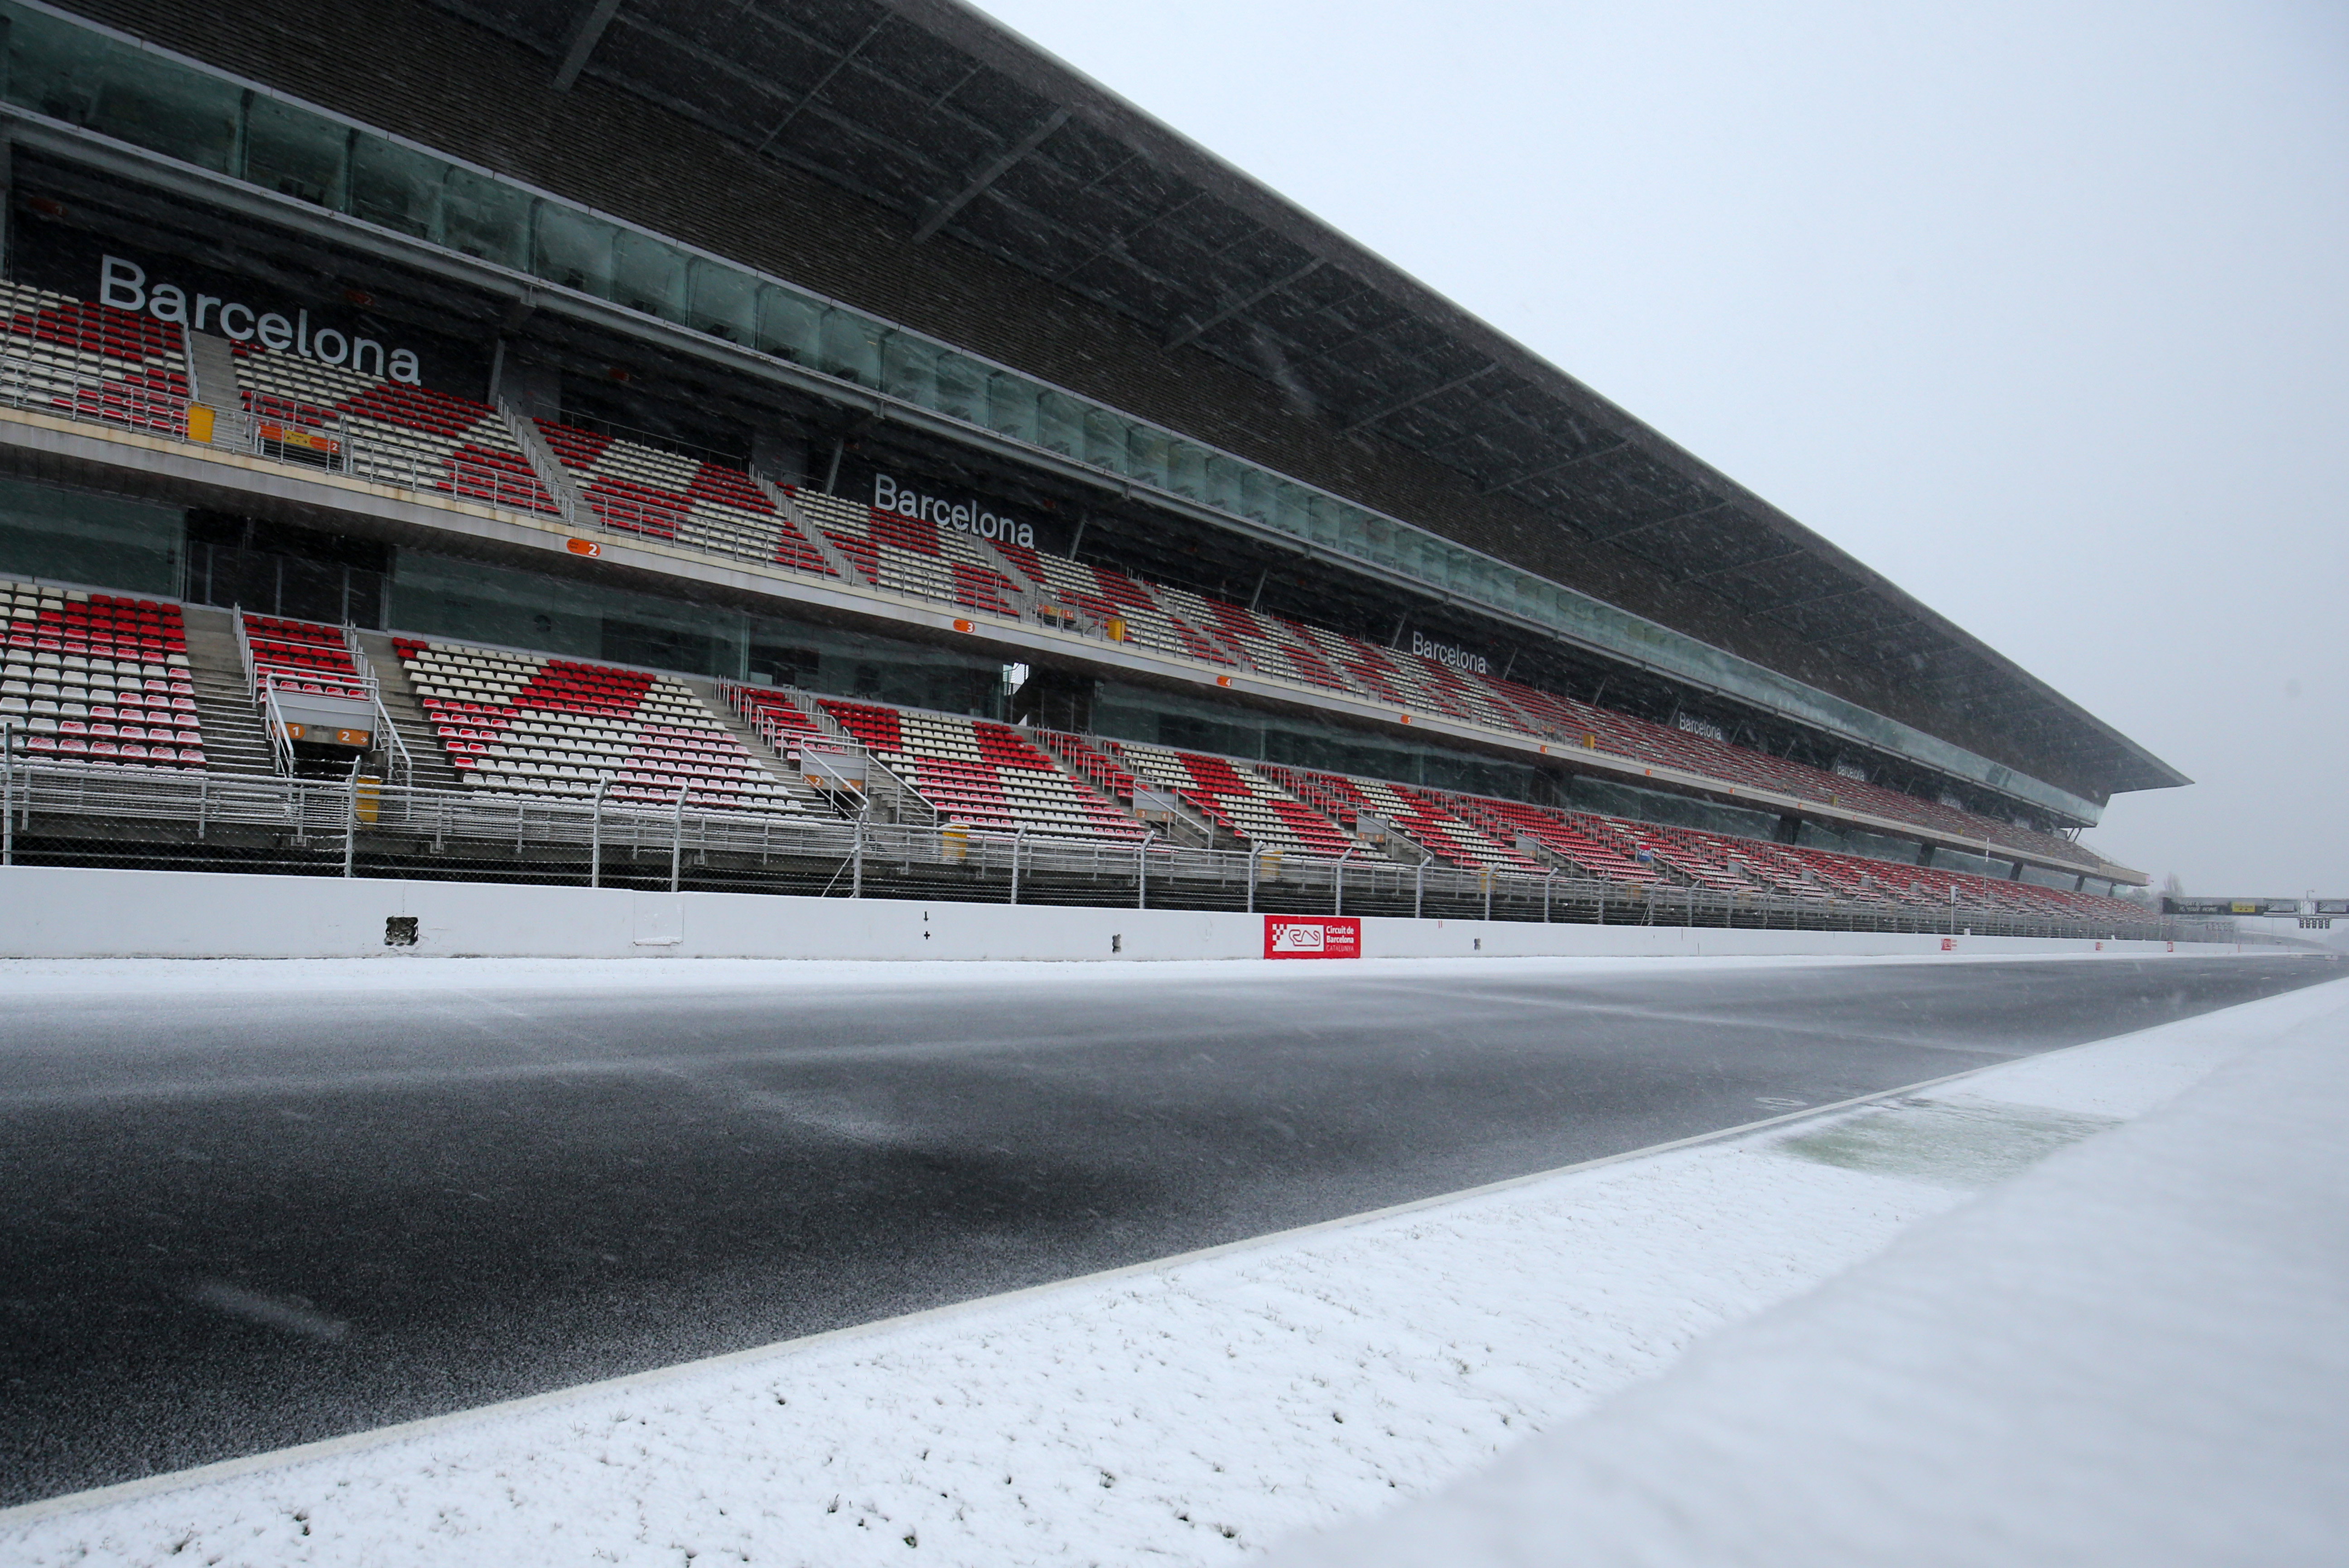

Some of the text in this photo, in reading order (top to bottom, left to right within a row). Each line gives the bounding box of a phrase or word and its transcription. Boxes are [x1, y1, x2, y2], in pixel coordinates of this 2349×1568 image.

[100, 254, 421, 386] Barcelona
[331, 443, 338, 451] 2
[875, 473, 1034, 549] Barcelona
[588, 543, 598, 556] 2
[967, 622, 974, 632] 3
[1413, 631, 1486, 674] Barcelona
[1225, 678, 1231, 687] 4
[1679, 712, 1722, 740] Barcelona
[292, 726, 350, 741] 1 2
[815, 777, 820, 786] 2
[1326, 925, 1354, 935] Circuit de
[1326, 935, 1354, 943] Barcelona
